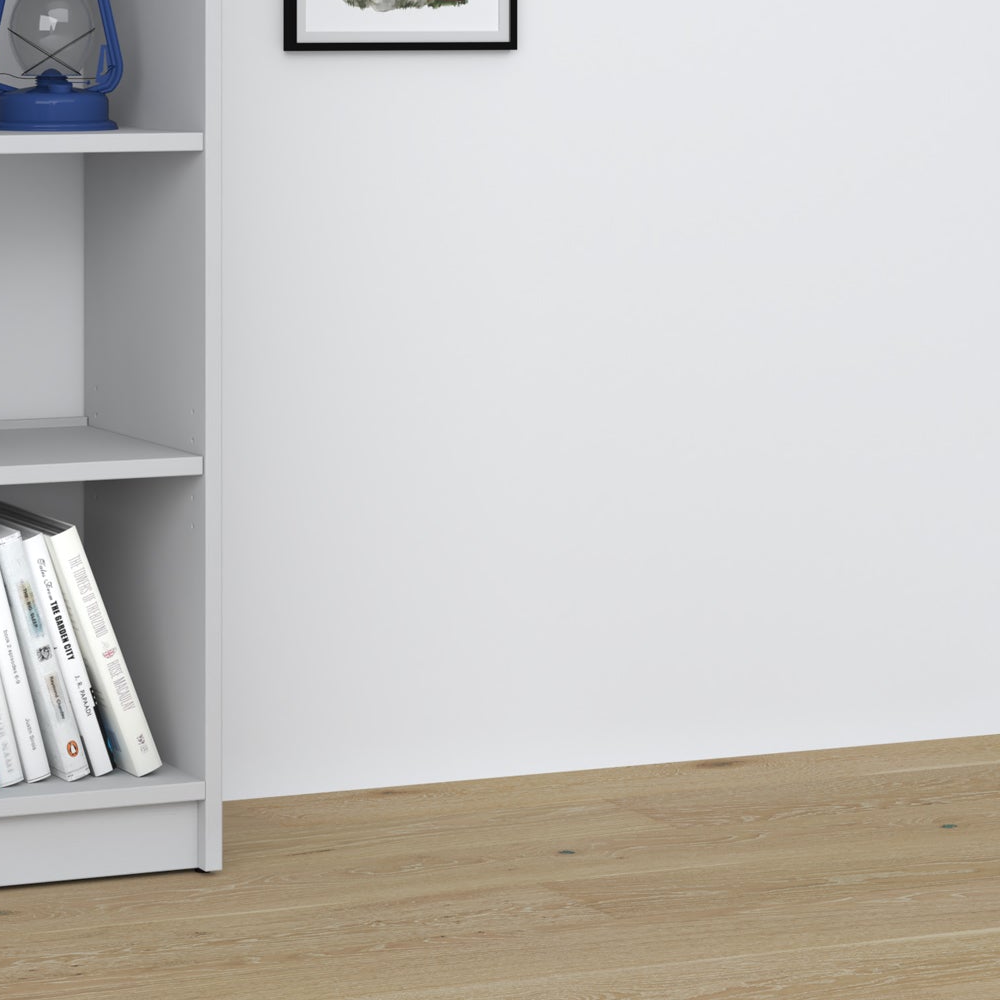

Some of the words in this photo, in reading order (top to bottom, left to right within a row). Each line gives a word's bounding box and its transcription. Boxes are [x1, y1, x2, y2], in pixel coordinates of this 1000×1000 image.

[68, 555, 83, 569] THE
[50, 600, 60, 615] THE
[55, 615, 69, 643] GARDEN
[63, 642, 75, 660] CITY
